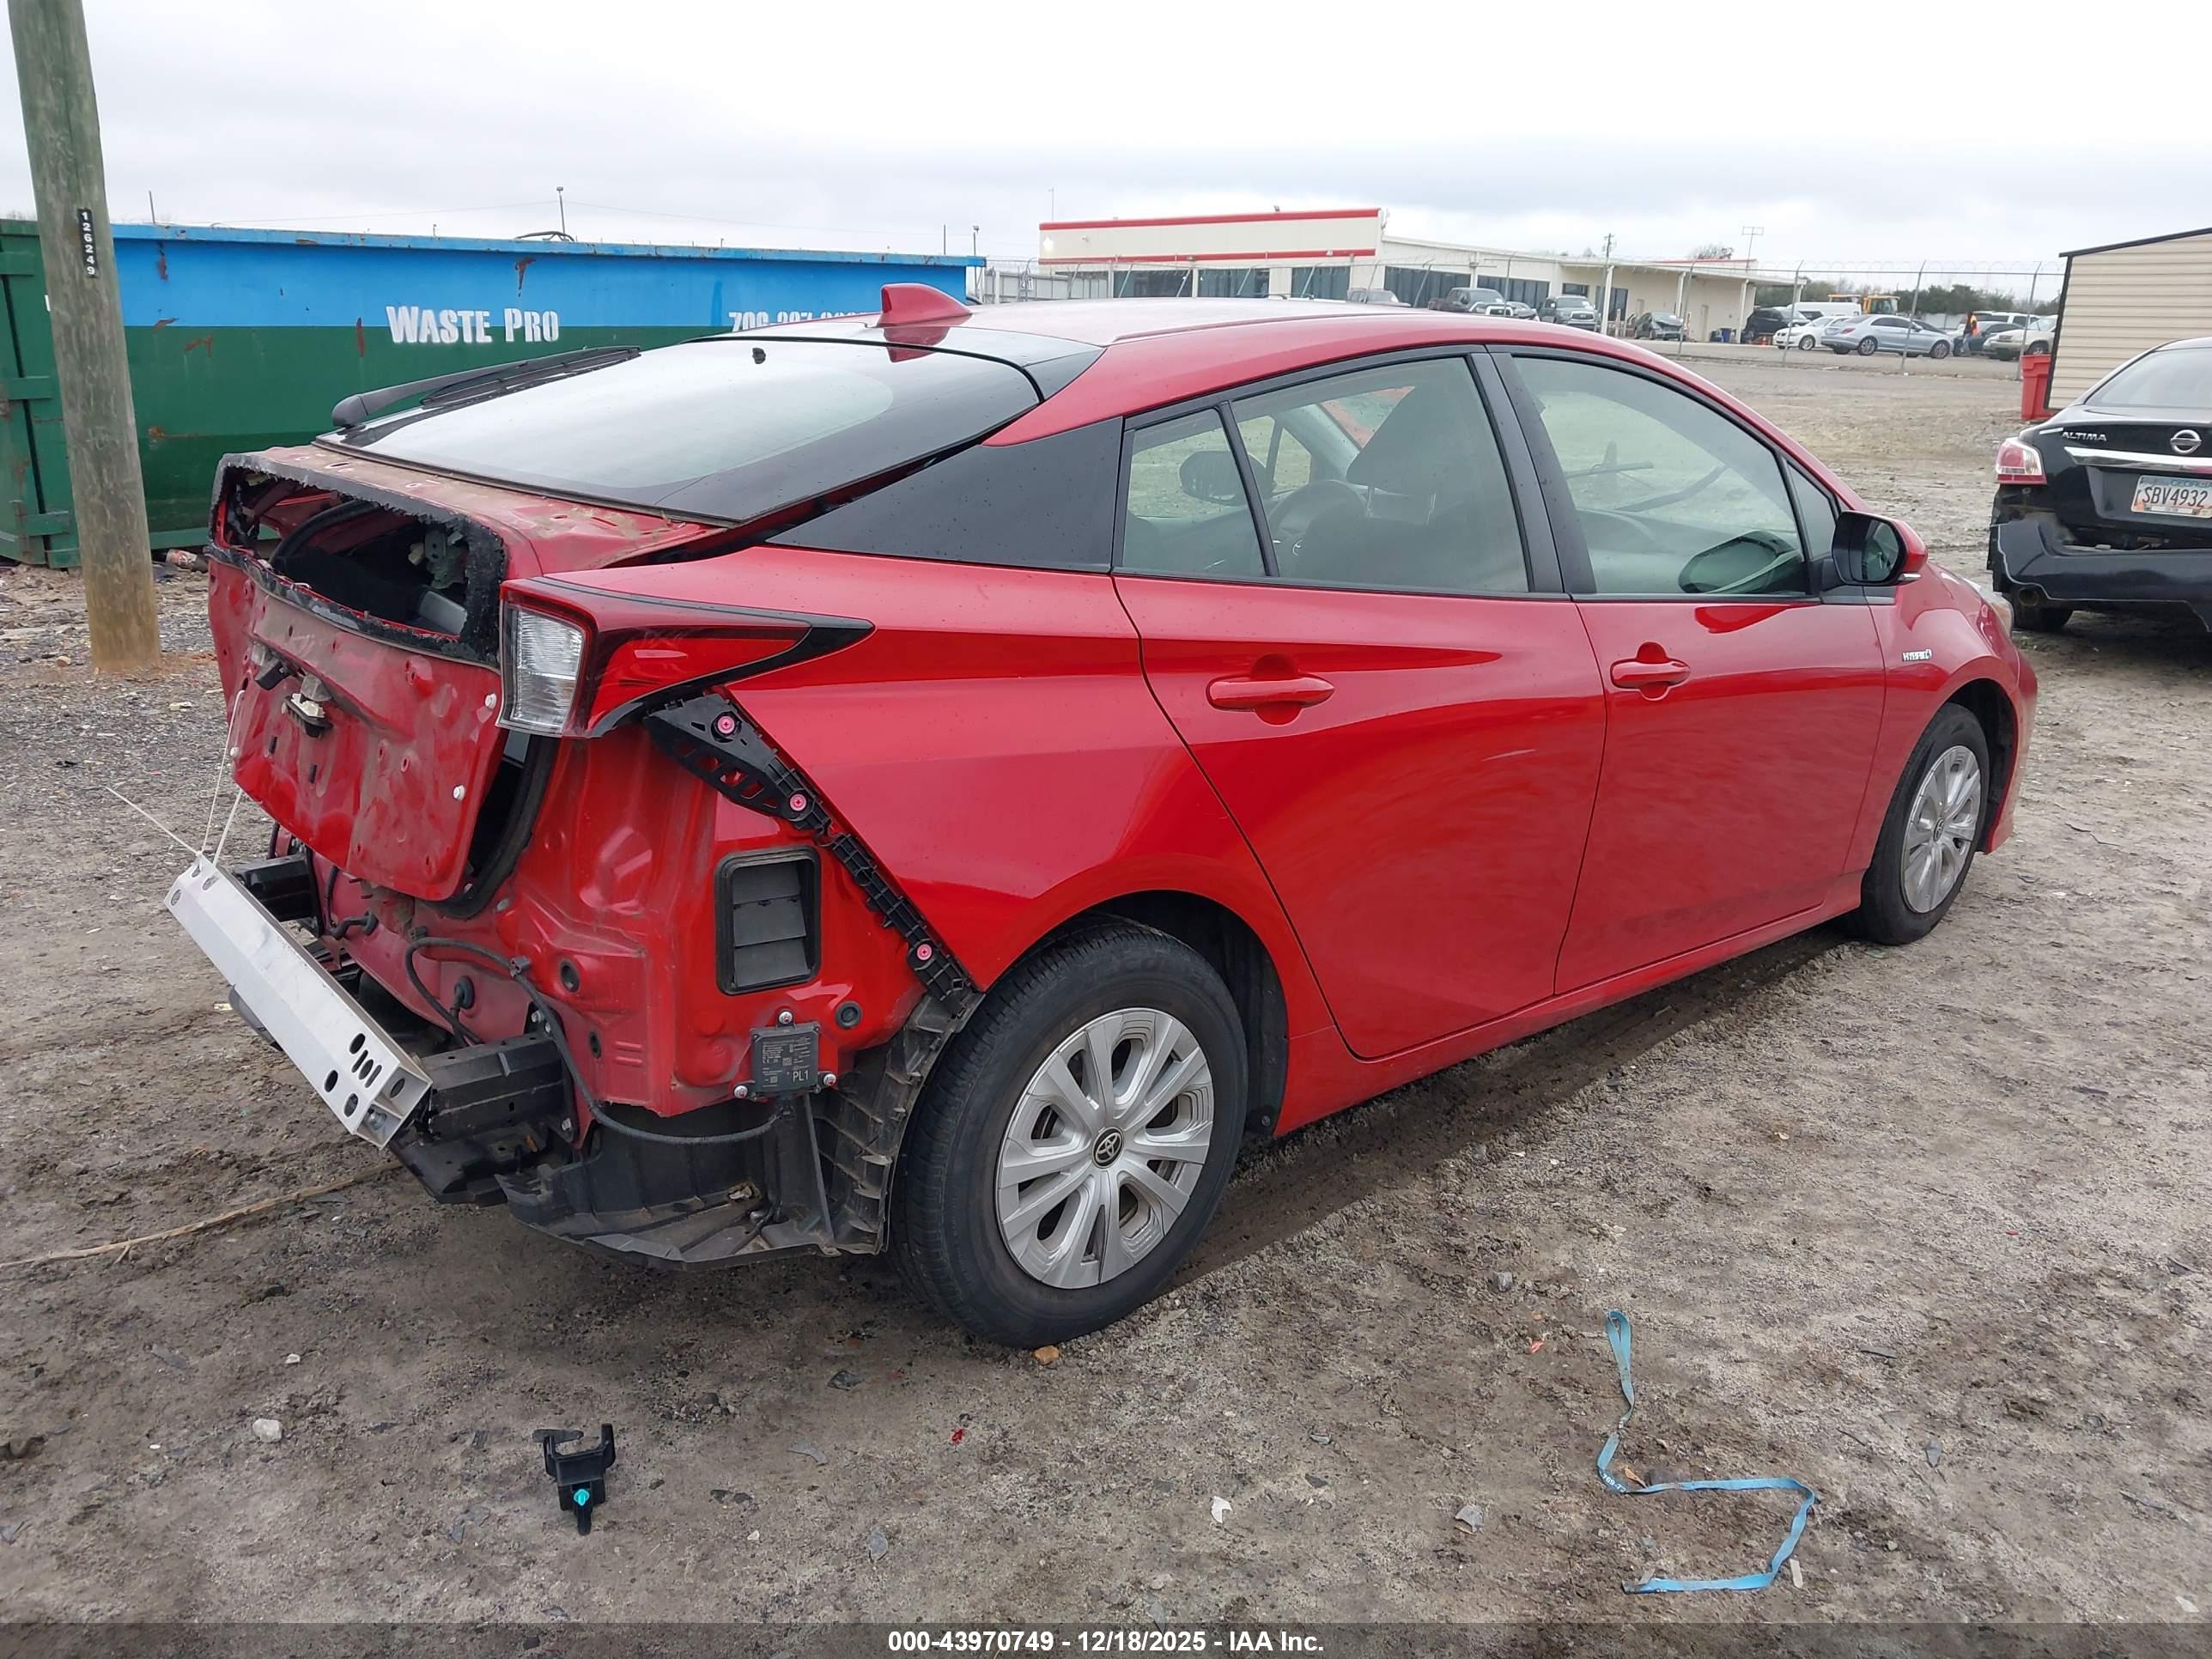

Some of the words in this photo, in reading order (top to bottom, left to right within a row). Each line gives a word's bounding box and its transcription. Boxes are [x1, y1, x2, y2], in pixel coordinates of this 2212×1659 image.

[82, 211, 96, 275] 126249
[386, 306, 493, 343] WASTE
[503, 308, 559, 343] PRO
[2061, 431, 2108, 442] ALTIMA
[2142, 486, 2209, 508] SBV4932
[793, 1070, 809, 1083] PL1
